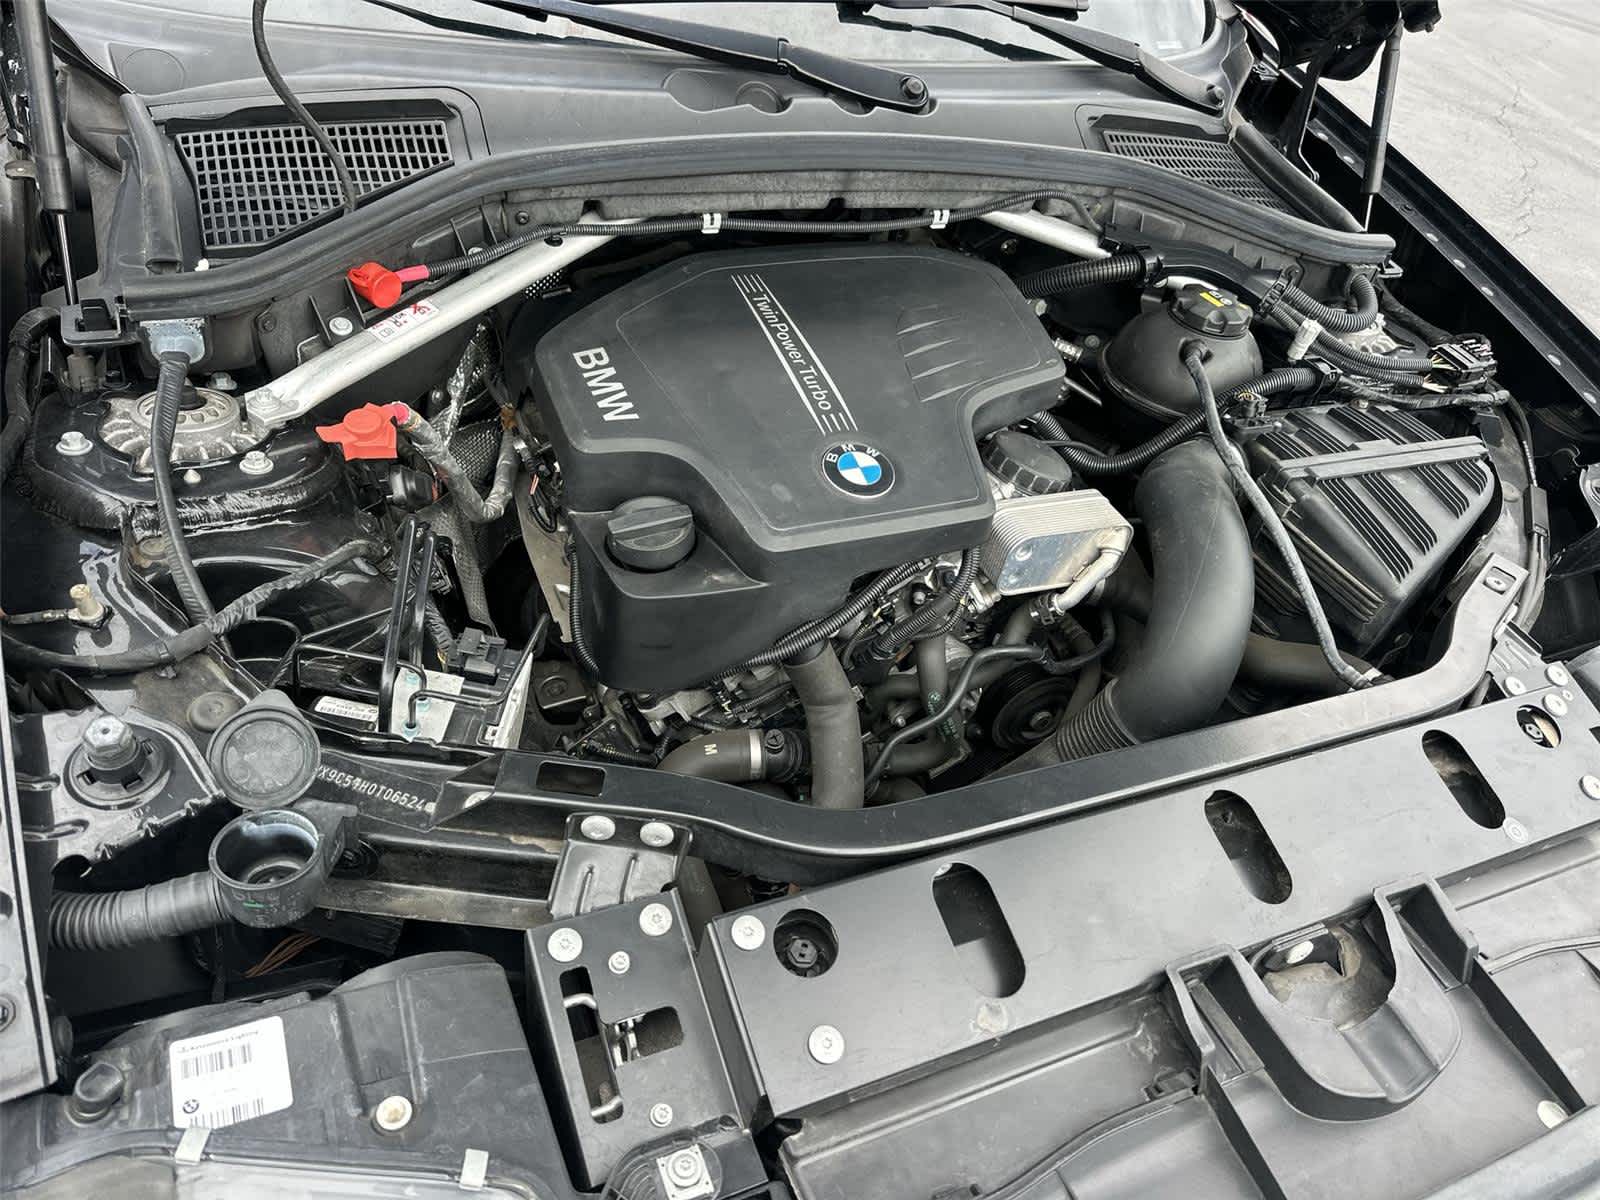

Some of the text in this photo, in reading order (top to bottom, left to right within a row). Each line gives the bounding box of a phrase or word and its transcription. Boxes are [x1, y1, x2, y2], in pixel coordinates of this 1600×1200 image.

[753, 294, 831, 410] TwinPower Turbo
[572, 346, 640, 423] BMW
[826, 443, 880, 464] BMW
[704, 743, 718, 756] M
